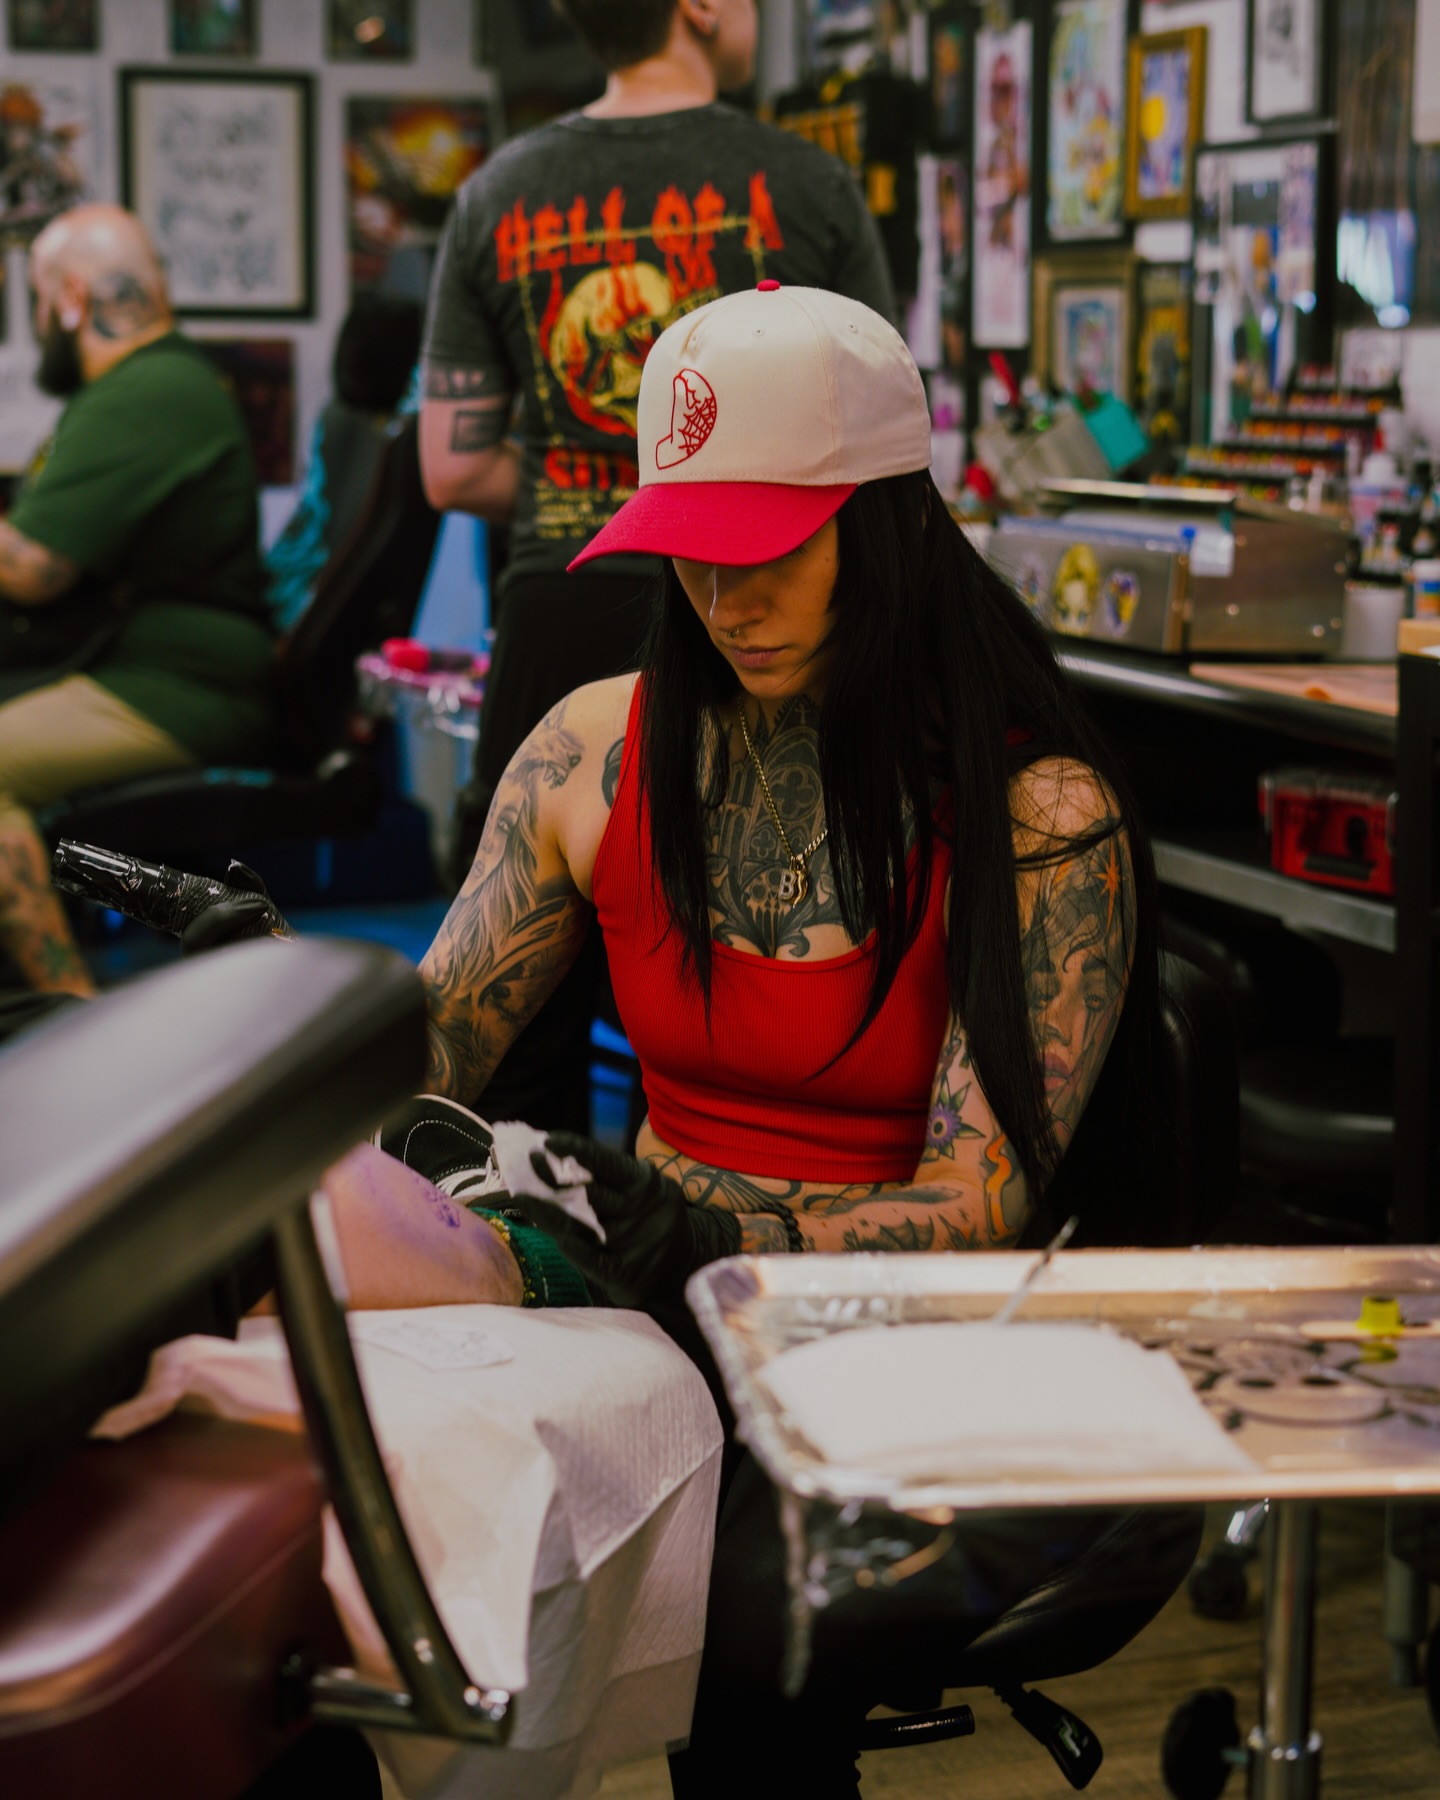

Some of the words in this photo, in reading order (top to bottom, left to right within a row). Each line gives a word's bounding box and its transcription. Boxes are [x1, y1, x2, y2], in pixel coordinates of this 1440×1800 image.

[494, 186, 637, 284] HELL
[652, 180, 726, 256] OF
[744, 170, 784, 251] A
